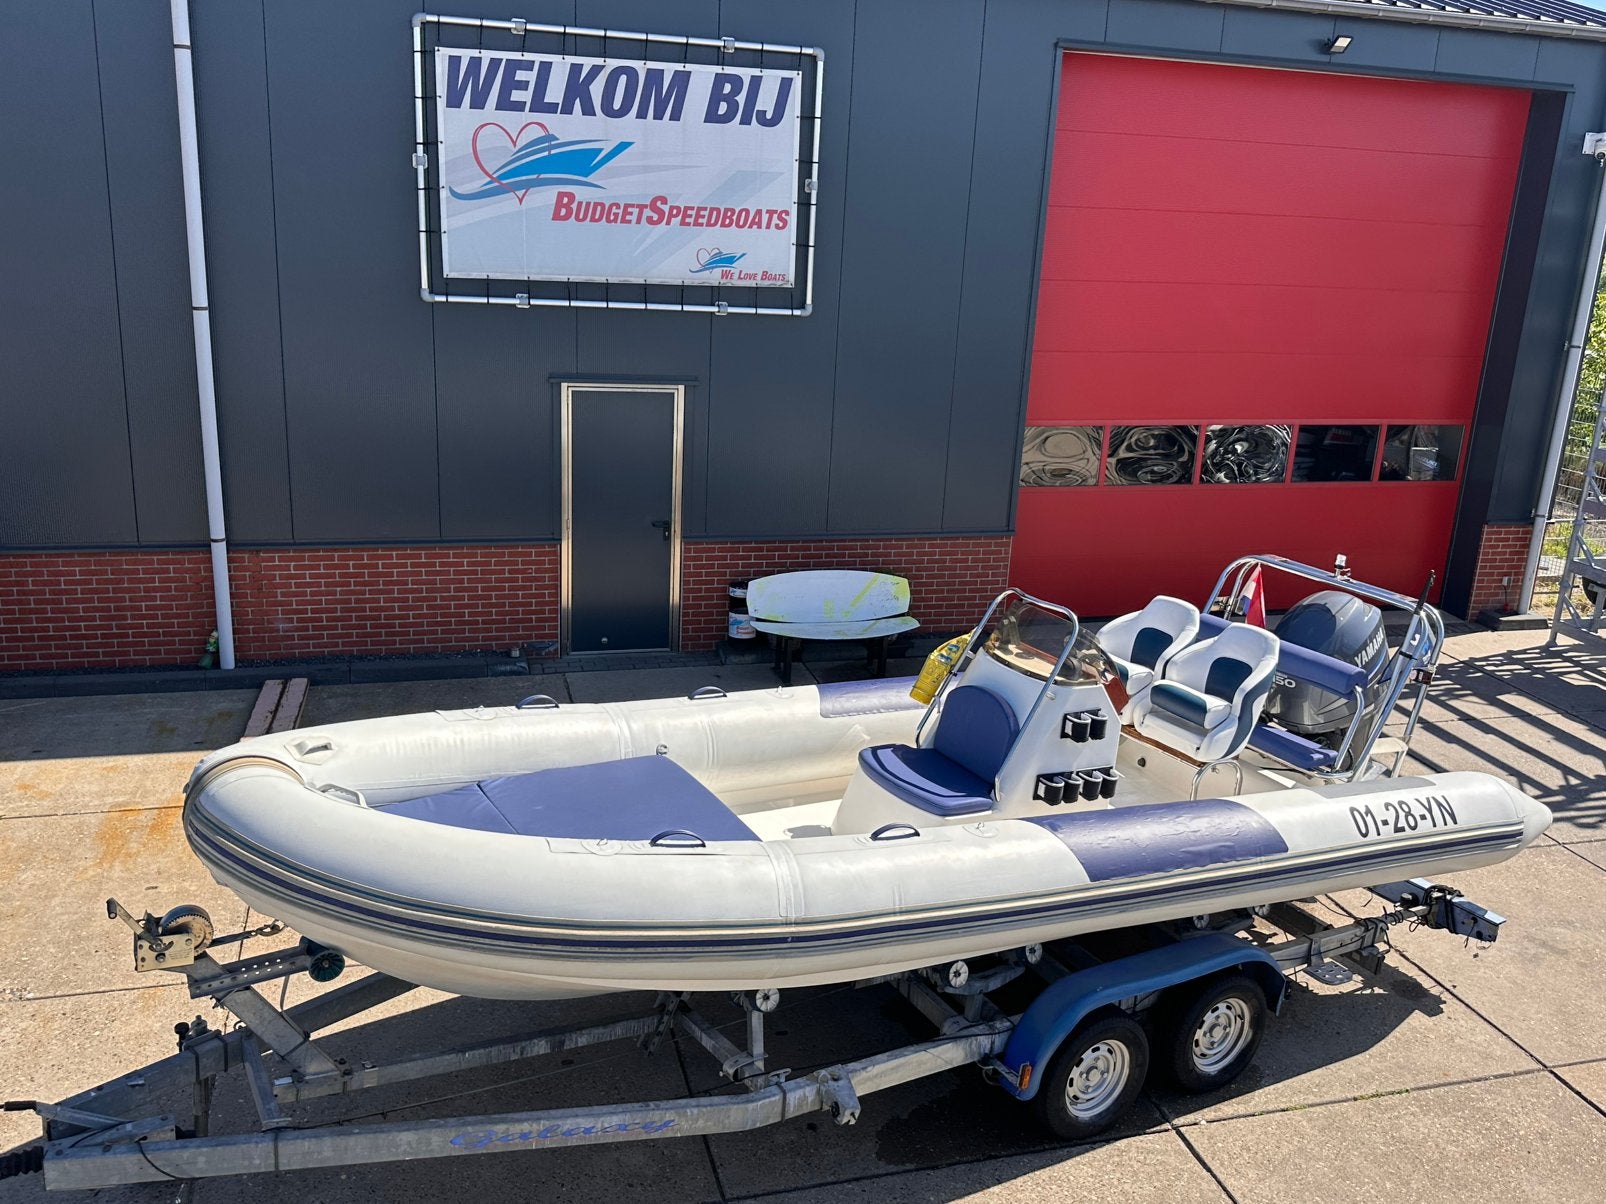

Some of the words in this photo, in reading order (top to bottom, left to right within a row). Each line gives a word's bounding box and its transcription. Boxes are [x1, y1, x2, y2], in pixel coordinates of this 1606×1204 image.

[445, 54, 692, 123] WELKOM
[703, 72, 794, 128] BIJ
[1353, 627, 1385, 668] YAMAHA
[1349, 795, 1458, 838] 01-28-YN
[450, 1118, 679, 1148] Galaxy
